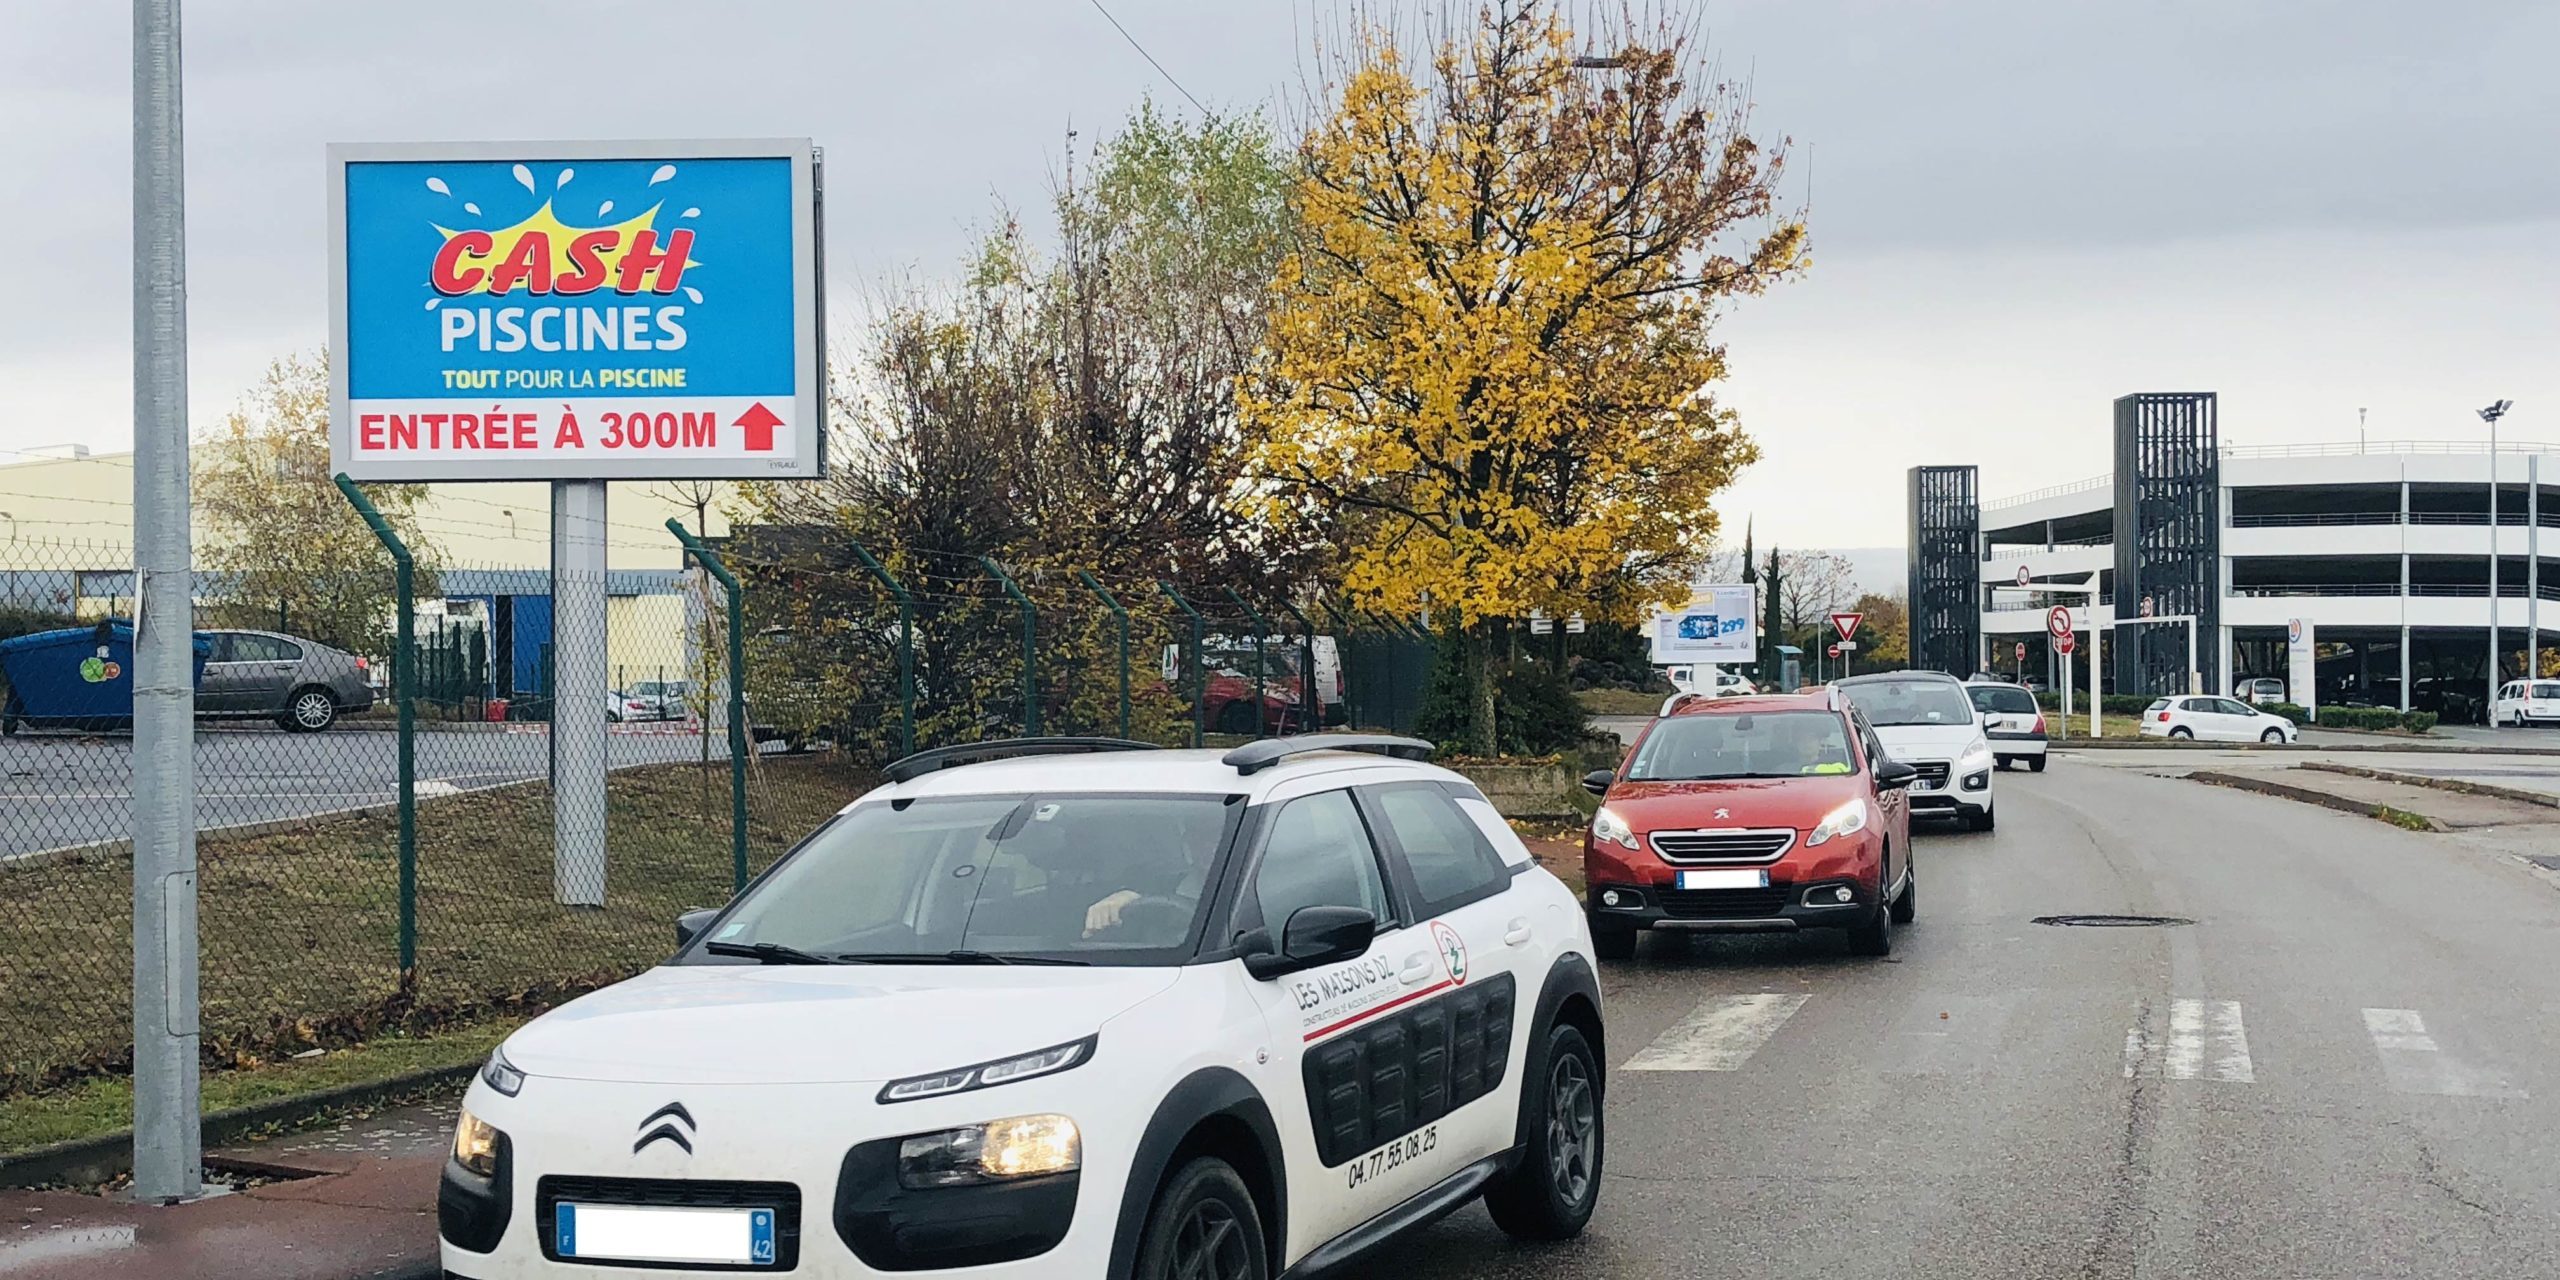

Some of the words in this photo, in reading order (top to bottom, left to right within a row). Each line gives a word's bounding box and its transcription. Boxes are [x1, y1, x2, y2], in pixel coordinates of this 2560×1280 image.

[430, 228, 696, 296] CASH
[441, 306, 687, 352] PISCINES
[442, 370, 500, 389] TOUT
[505, 370, 563, 388] POUR
[570, 370, 594, 388] LA
[600, 368, 687, 388] PISCINE
[360, 405, 538, 450] ENTRÉE
[554, 404, 584, 448] À
[600, 412, 716, 449] 300M
[1720, 618, 1745, 633] 299
[2056, 637, 2071, 646] SOP
[1290, 982, 1320, 1011] LES
[1317, 962, 1376, 1001] MAISONS
[1372, 954, 1394, 980] DZ
[1349, 1125, 1437, 1189] 04.77.55.08.25
[753, 1240, 771, 1258] 42
